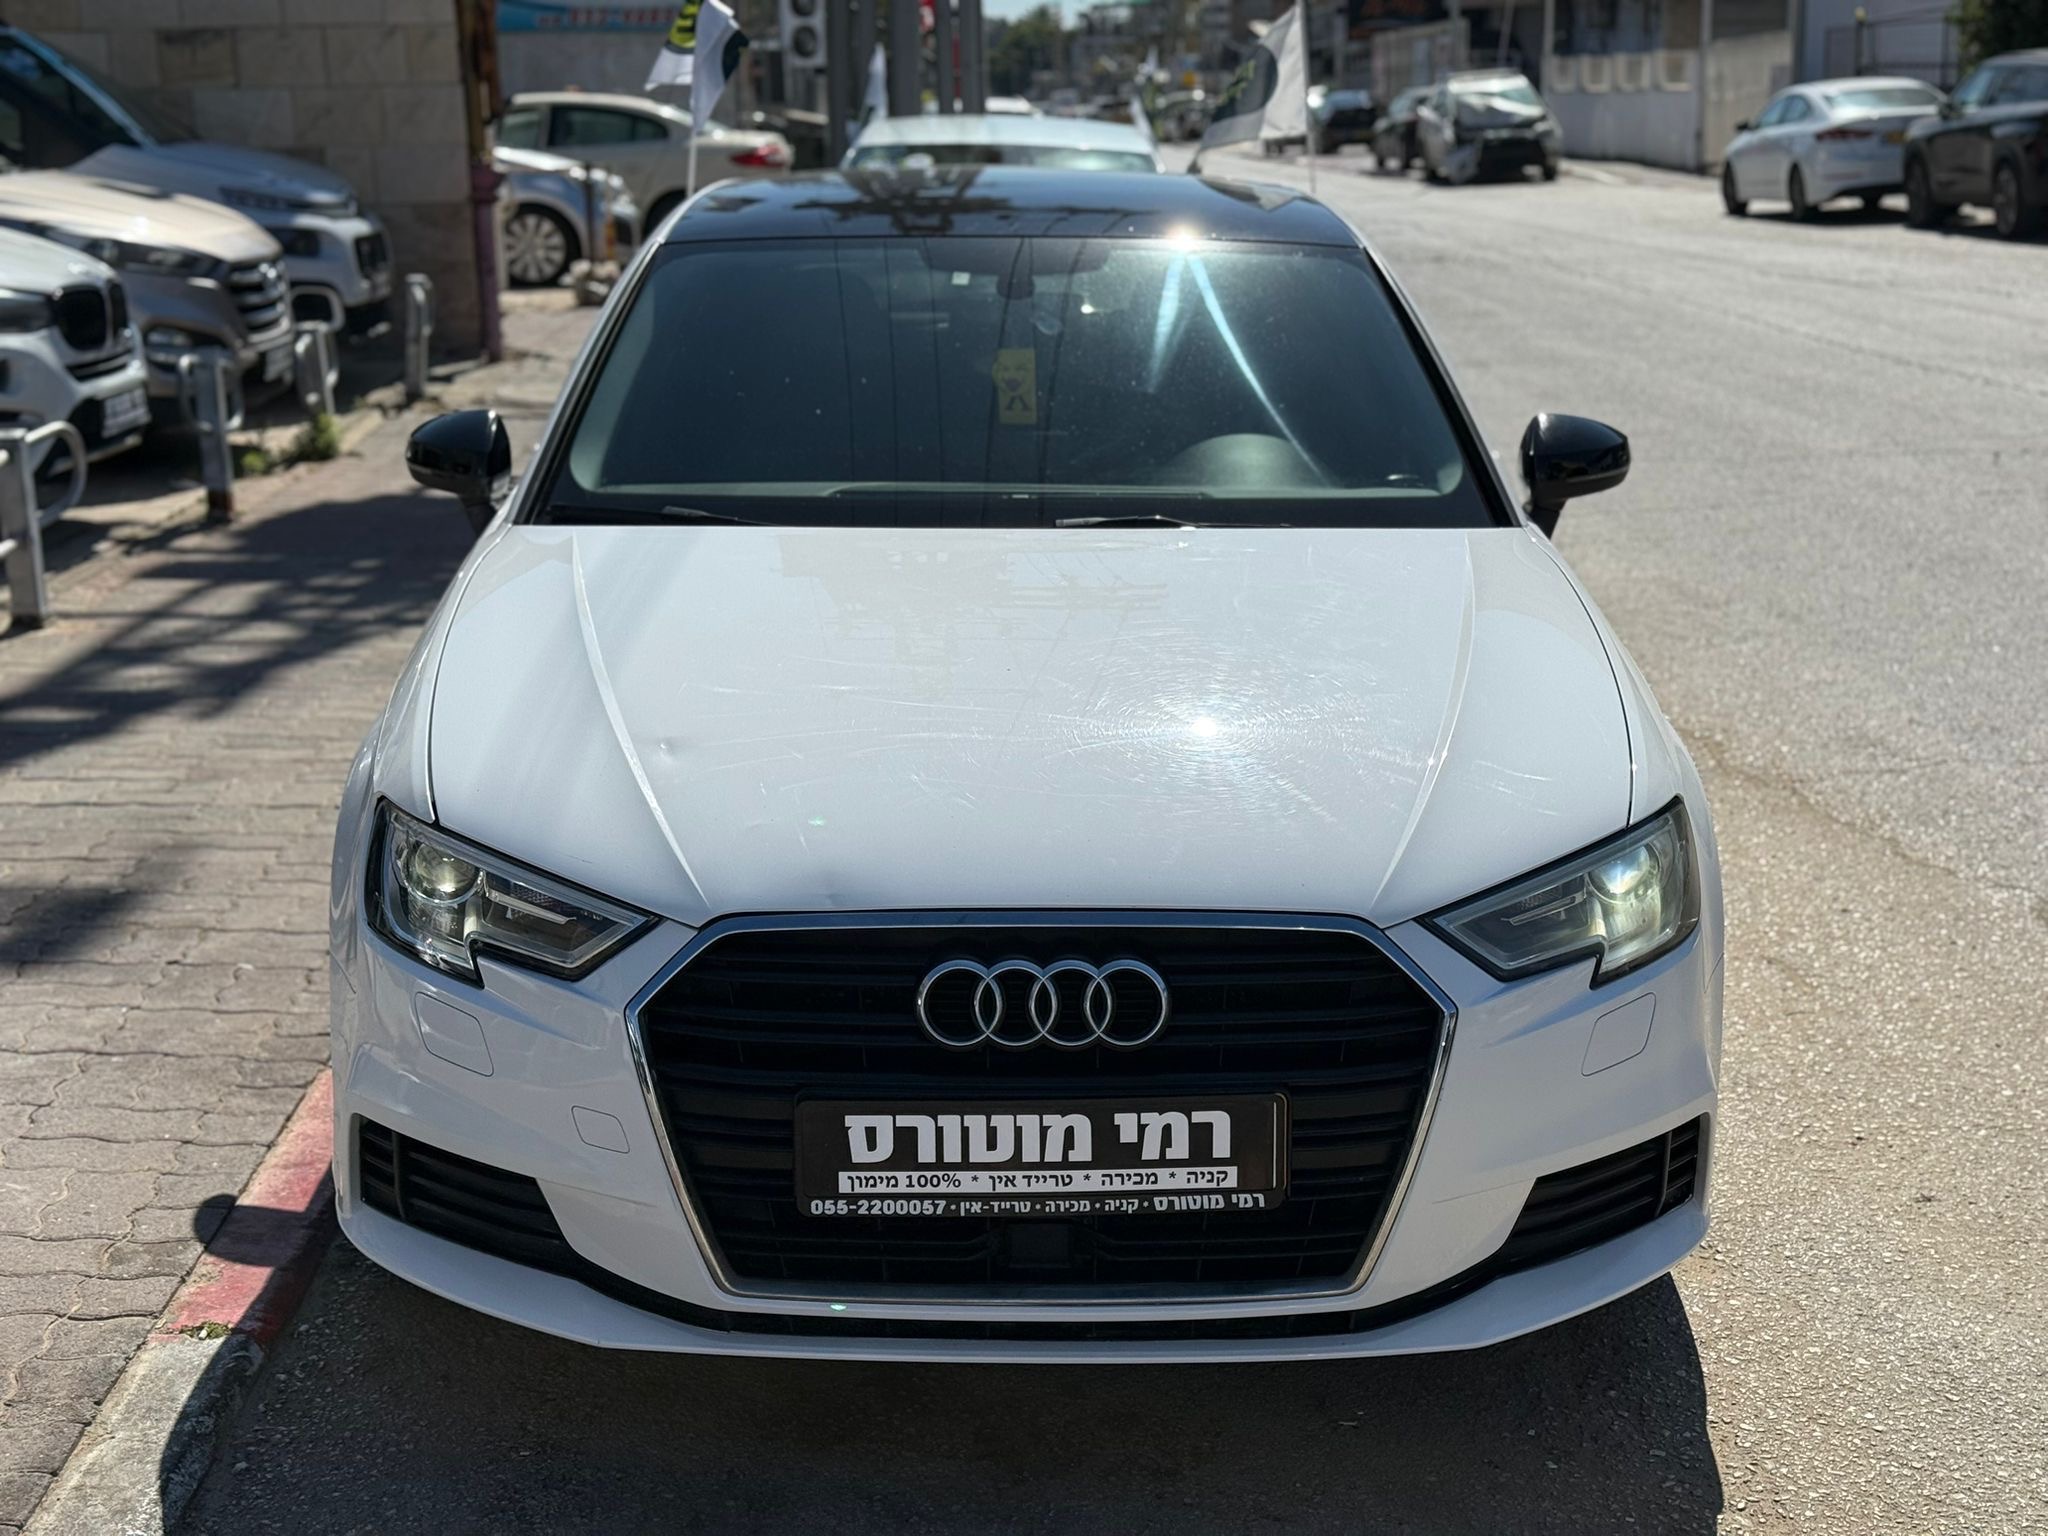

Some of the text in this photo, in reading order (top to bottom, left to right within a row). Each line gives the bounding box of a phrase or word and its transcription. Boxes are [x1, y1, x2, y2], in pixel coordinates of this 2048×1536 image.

[844, 1110, 1231, 1164] רמי מוטורס
[847, 1169, 1229, 1192] קניה מכירה טרייד אין 100% מימון
[810, 1193, 1265, 1217] רמי מוטורס קניה מכירה טרייד-אין 055-2200057
